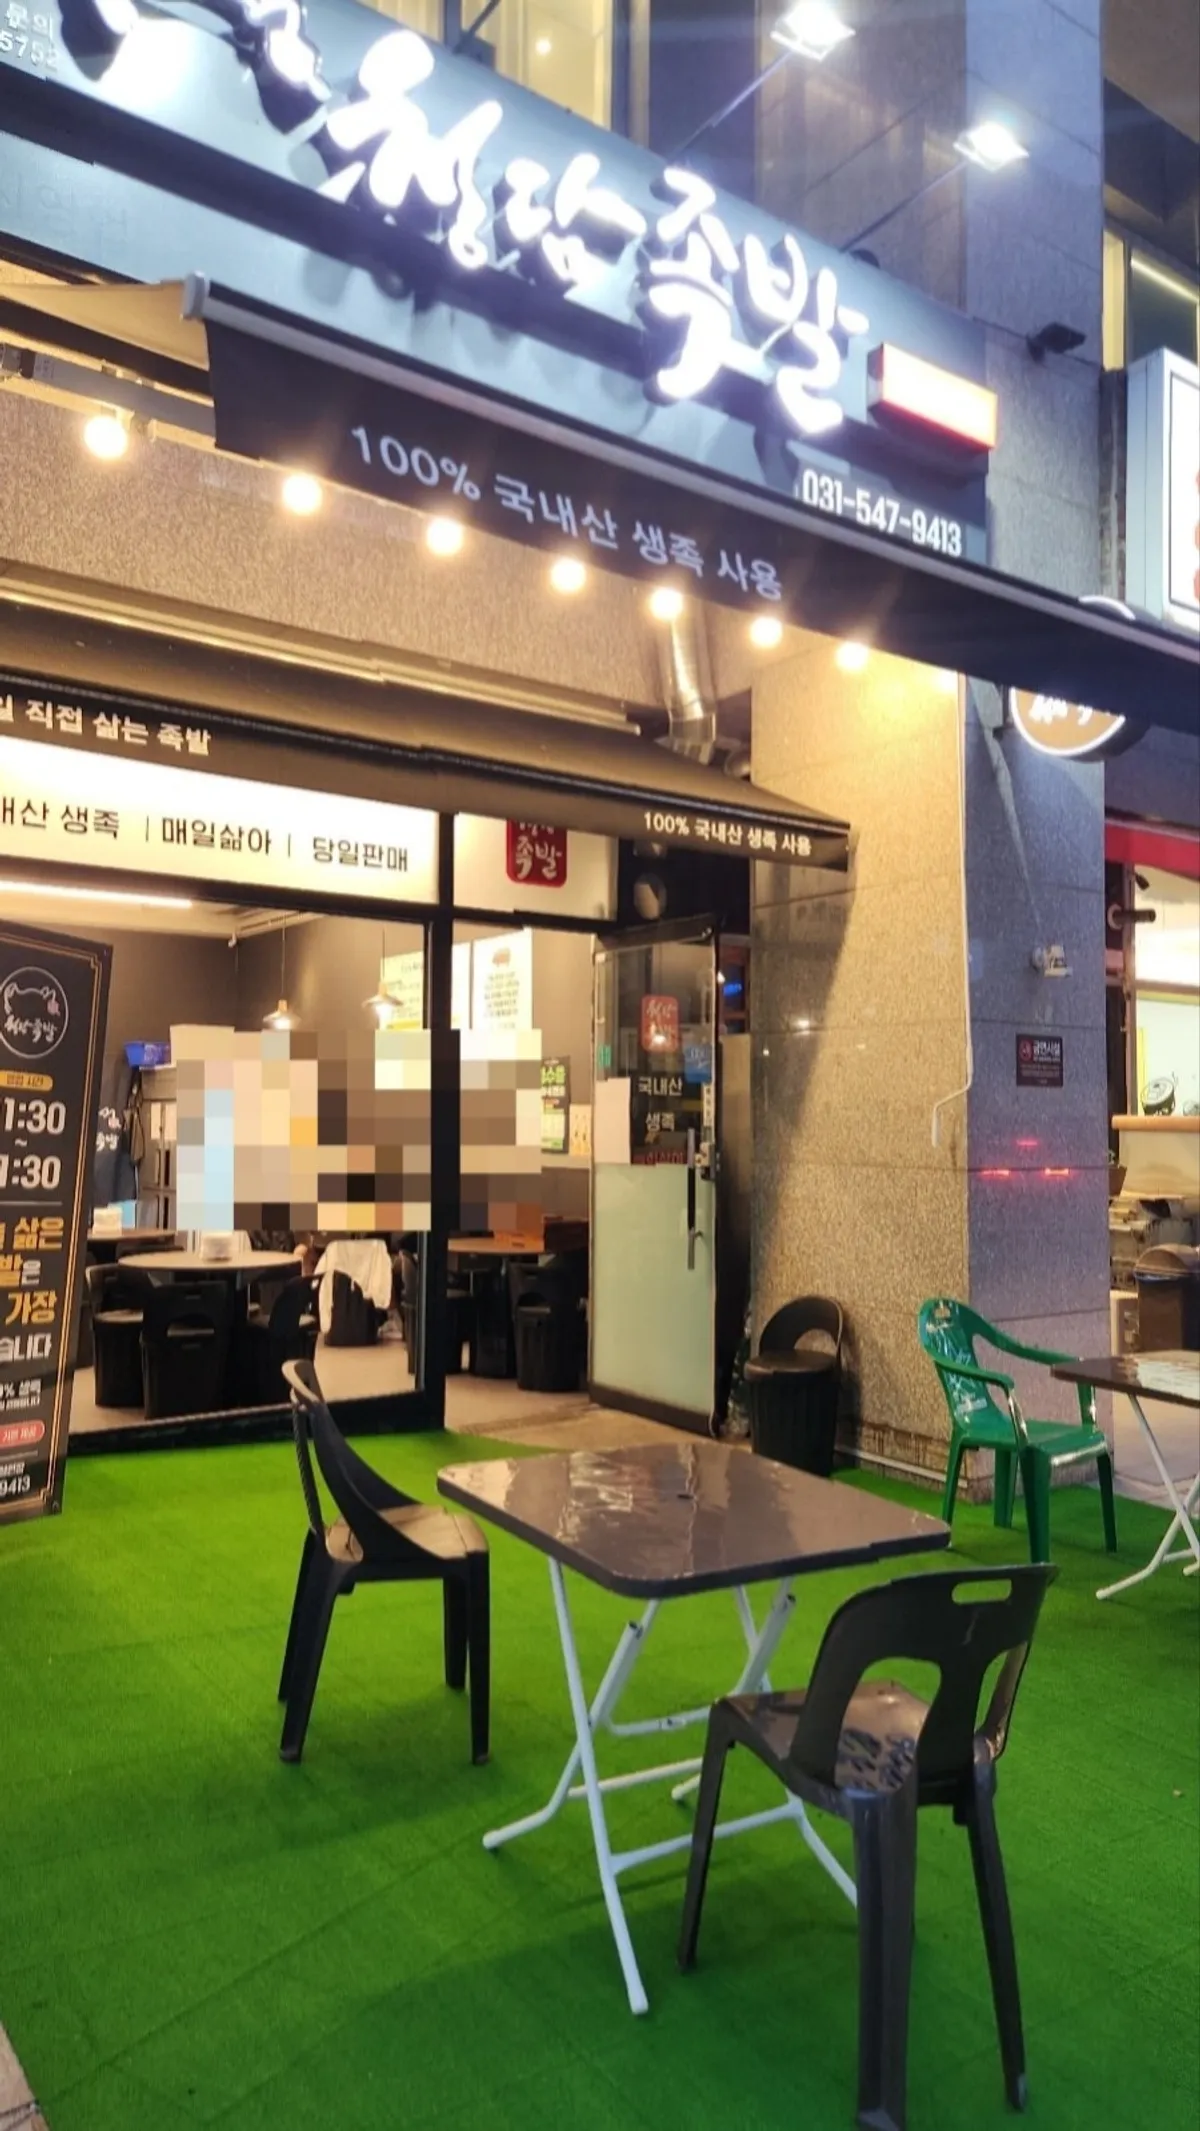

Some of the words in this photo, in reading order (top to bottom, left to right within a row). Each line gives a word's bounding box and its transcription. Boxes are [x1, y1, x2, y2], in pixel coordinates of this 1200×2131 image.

[352, 426, 481, 500] 100%
[495, 474, 619, 550] 국내산
[632, 521, 704, 577] 생족
[718, 550, 782, 599] 사용
[801, 469, 962, 557] 031-547-9413
[25, 699, 83, 735] 직접
[93, 711, 149, 746] 삶는
[157, 722, 211, 756] 족발
[61, 804, 119, 840] 생족
[162, 816, 272, 855] 매일삶아
[313, 836, 408, 872] 당일판매
[644, 811, 690, 836] 100%
[694, 818, 742, 845] 국내산
[782, 833, 812, 856] 사용
[638, 1076, 683, 1096] 국내산
[13, 1216, 64, 1250] 삶은
[5, 1289, 57, 1325] 가장
